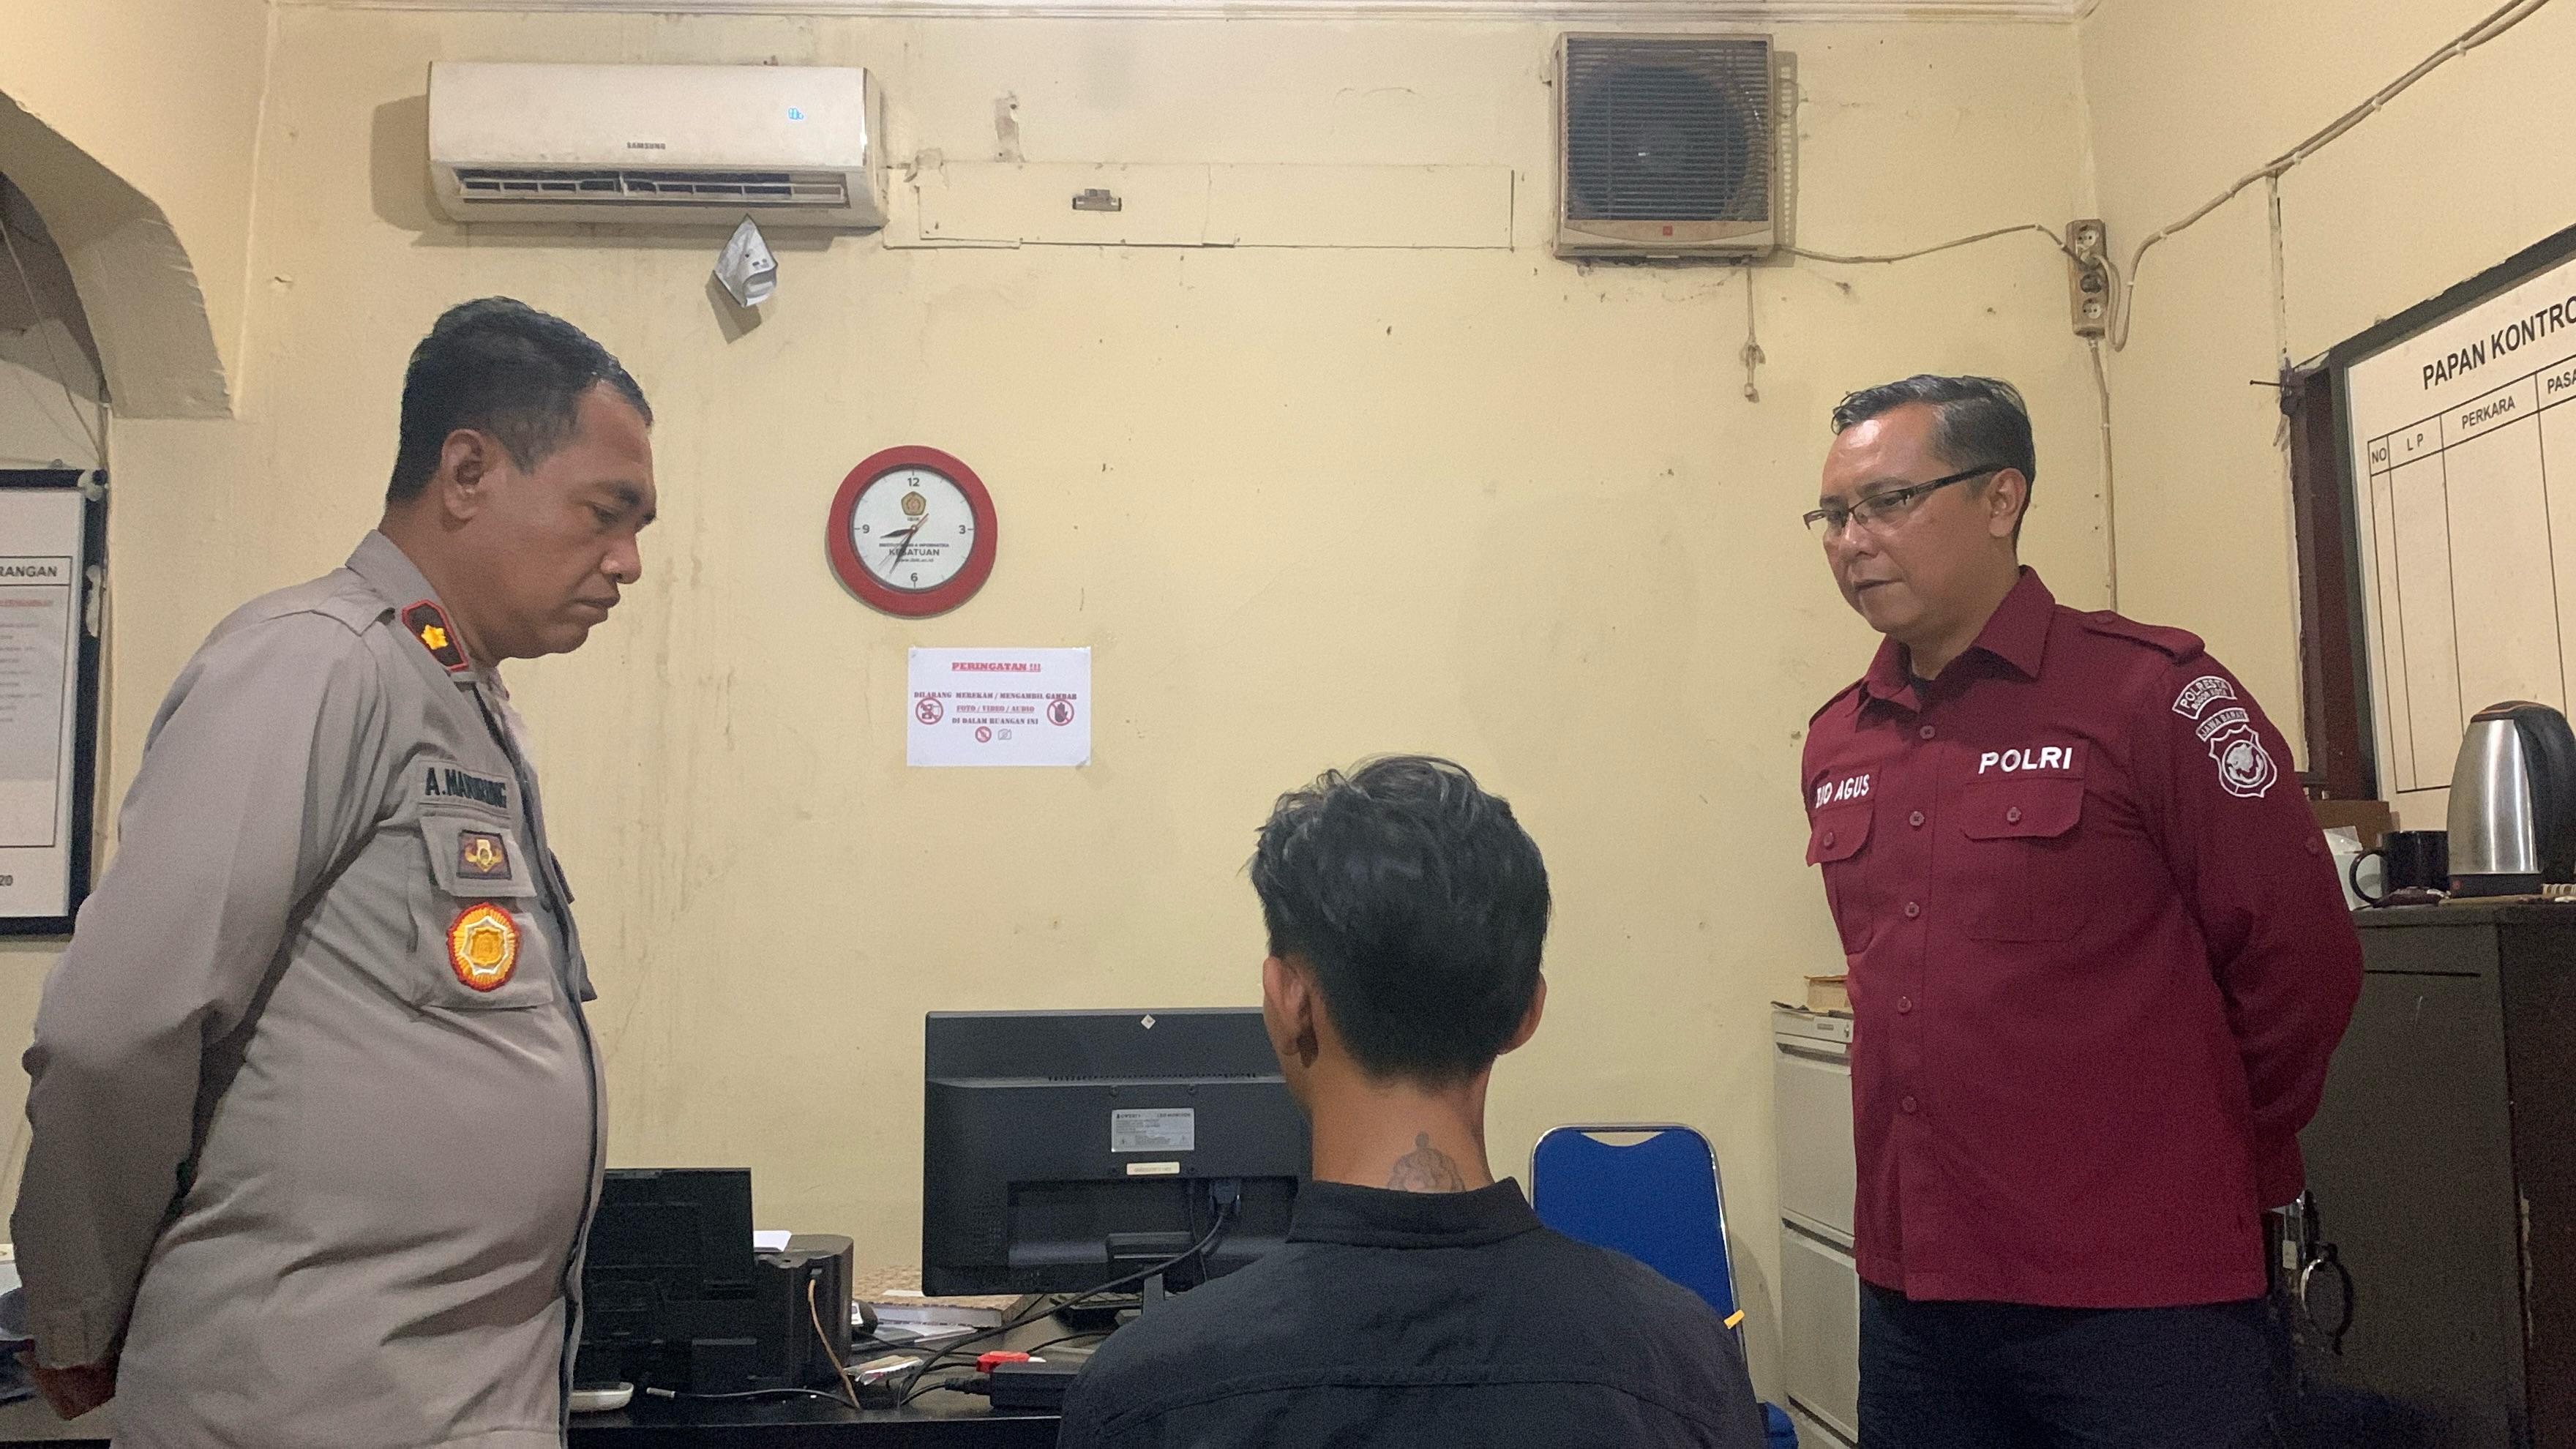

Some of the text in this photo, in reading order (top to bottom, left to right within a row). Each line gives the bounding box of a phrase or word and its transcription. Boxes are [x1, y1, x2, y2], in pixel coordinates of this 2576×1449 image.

[2422, 295, 2576, 390] PAPAN KONTRO
[2461, 396, 2515, 430] PERKARA
[2371, 446, 2387, 464] NO
[907, 478, 920, 487] 12
[862, 524, 870, 533] 9
[959, 525, 966, 534] 3
[910, 573, 918, 582] 6
[951, 662, 1027, 671] PERINGATAN
[2180, 679, 2229, 709] POLRESTA
[2201, 711, 2244, 737] JAWA BARAT
[1978, 746, 2073, 774] POLRI
[1833, 774, 1870, 802] AGUS
